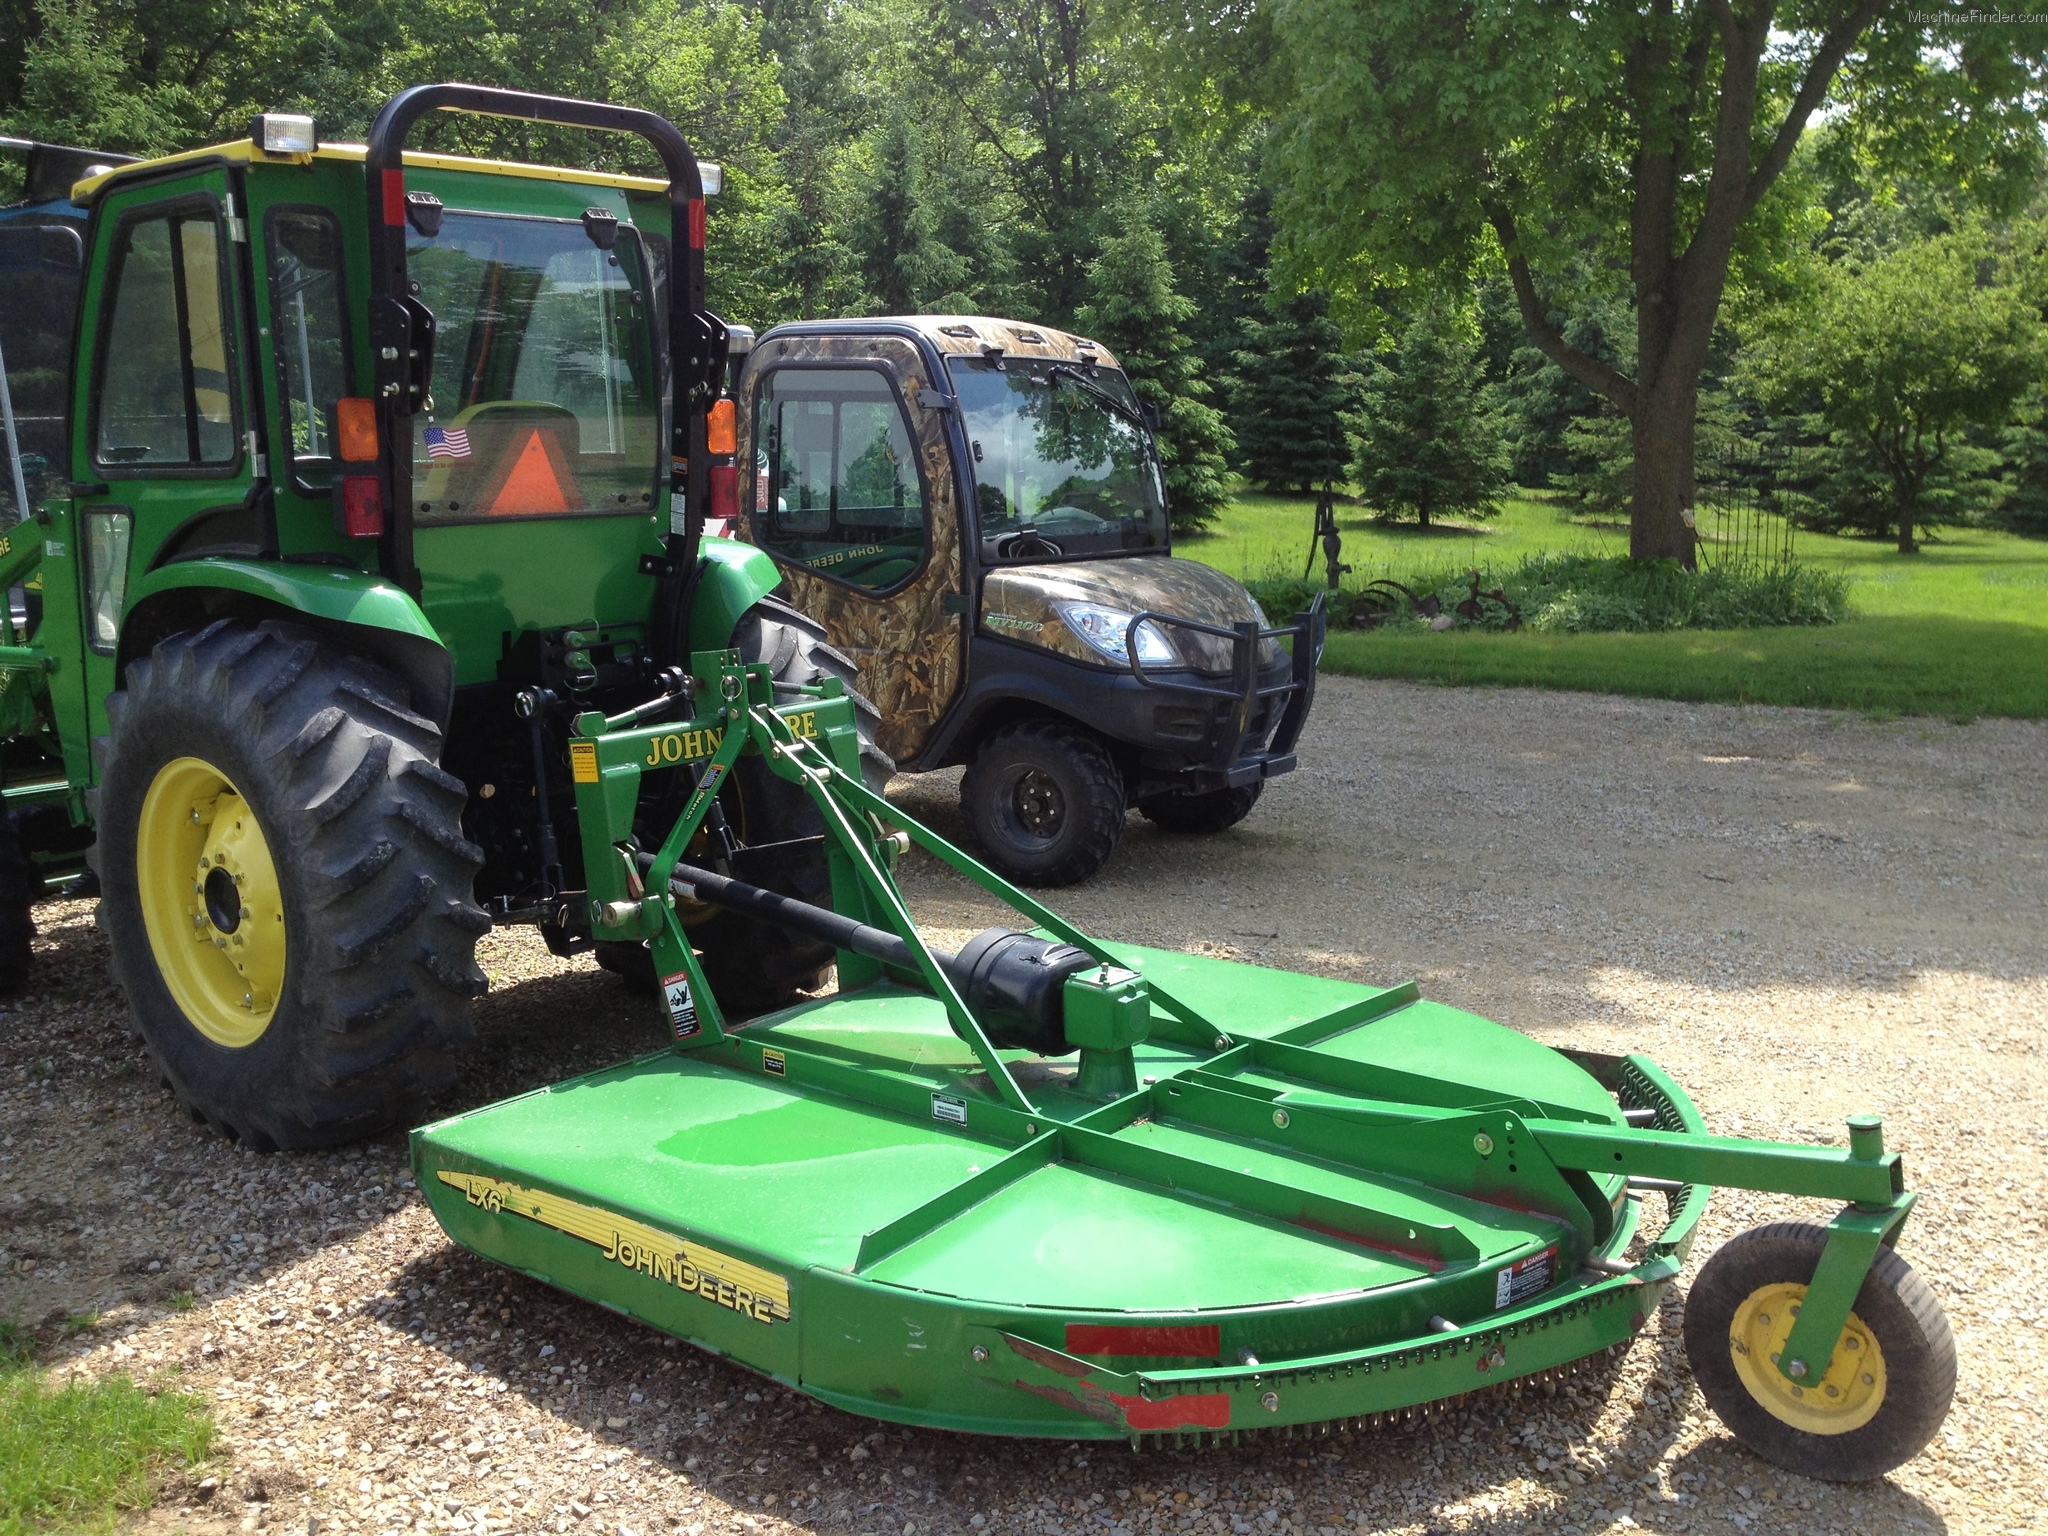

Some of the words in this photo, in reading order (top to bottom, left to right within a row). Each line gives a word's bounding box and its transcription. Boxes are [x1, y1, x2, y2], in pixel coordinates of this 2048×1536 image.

[646, 727, 723, 766] JOHN
[466, 1179, 502, 1214] LX6
[603, 1230, 673, 1283] JOHN
[677, 1259, 772, 1323] DEERE
